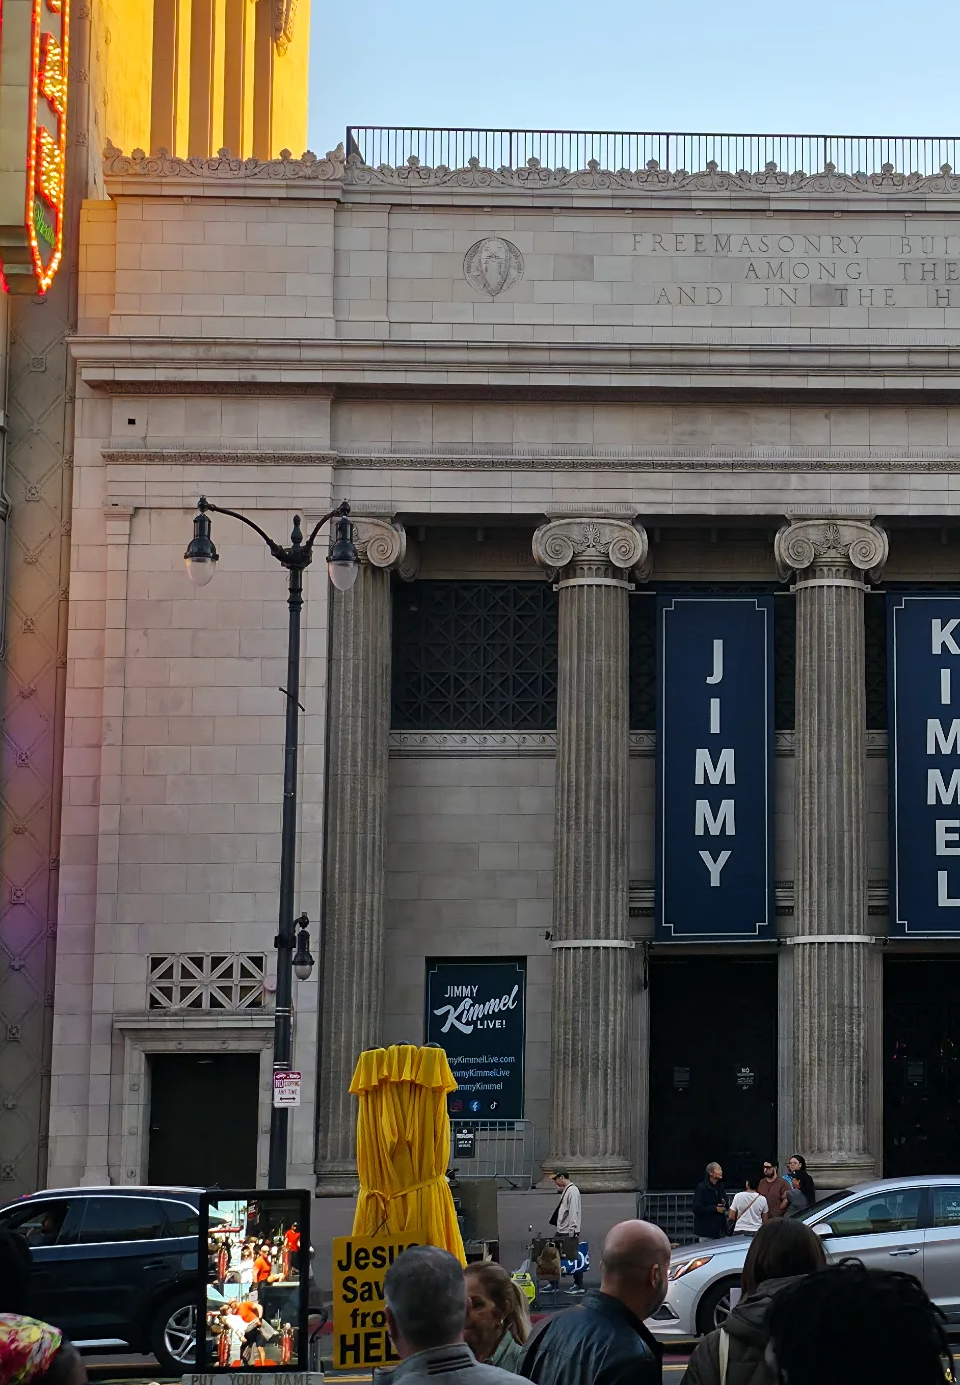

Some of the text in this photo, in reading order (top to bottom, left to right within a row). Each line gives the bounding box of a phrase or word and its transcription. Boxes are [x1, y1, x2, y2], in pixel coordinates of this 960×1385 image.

[632, 234, 863, 254] FREEMASONRY
[744, 261, 862, 280] AMONG
[898, 262, 960, 281] THE
[655, 286, 723, 305] AND
[764, 287, 799, 306] IN
[834, 288, 897, 306] THE
[694, 639, 736, 886] JIMMY
[444, 985, 479, 997] JIMMY
[433, 984, 519, 1035] Kimmel
[477, 1019, 506, 1029] LIVE!
[447, 1055, 516, 1066] myKimmelLive.com
[337, 1242, 419, 1272] Jesu
[342, 1275, 384, 1304] Sav
[350, 1308, 387, 1329] fro
[340, 1330, 404, 1365] HEL
[274, 1374, 313, 1385] NAME
